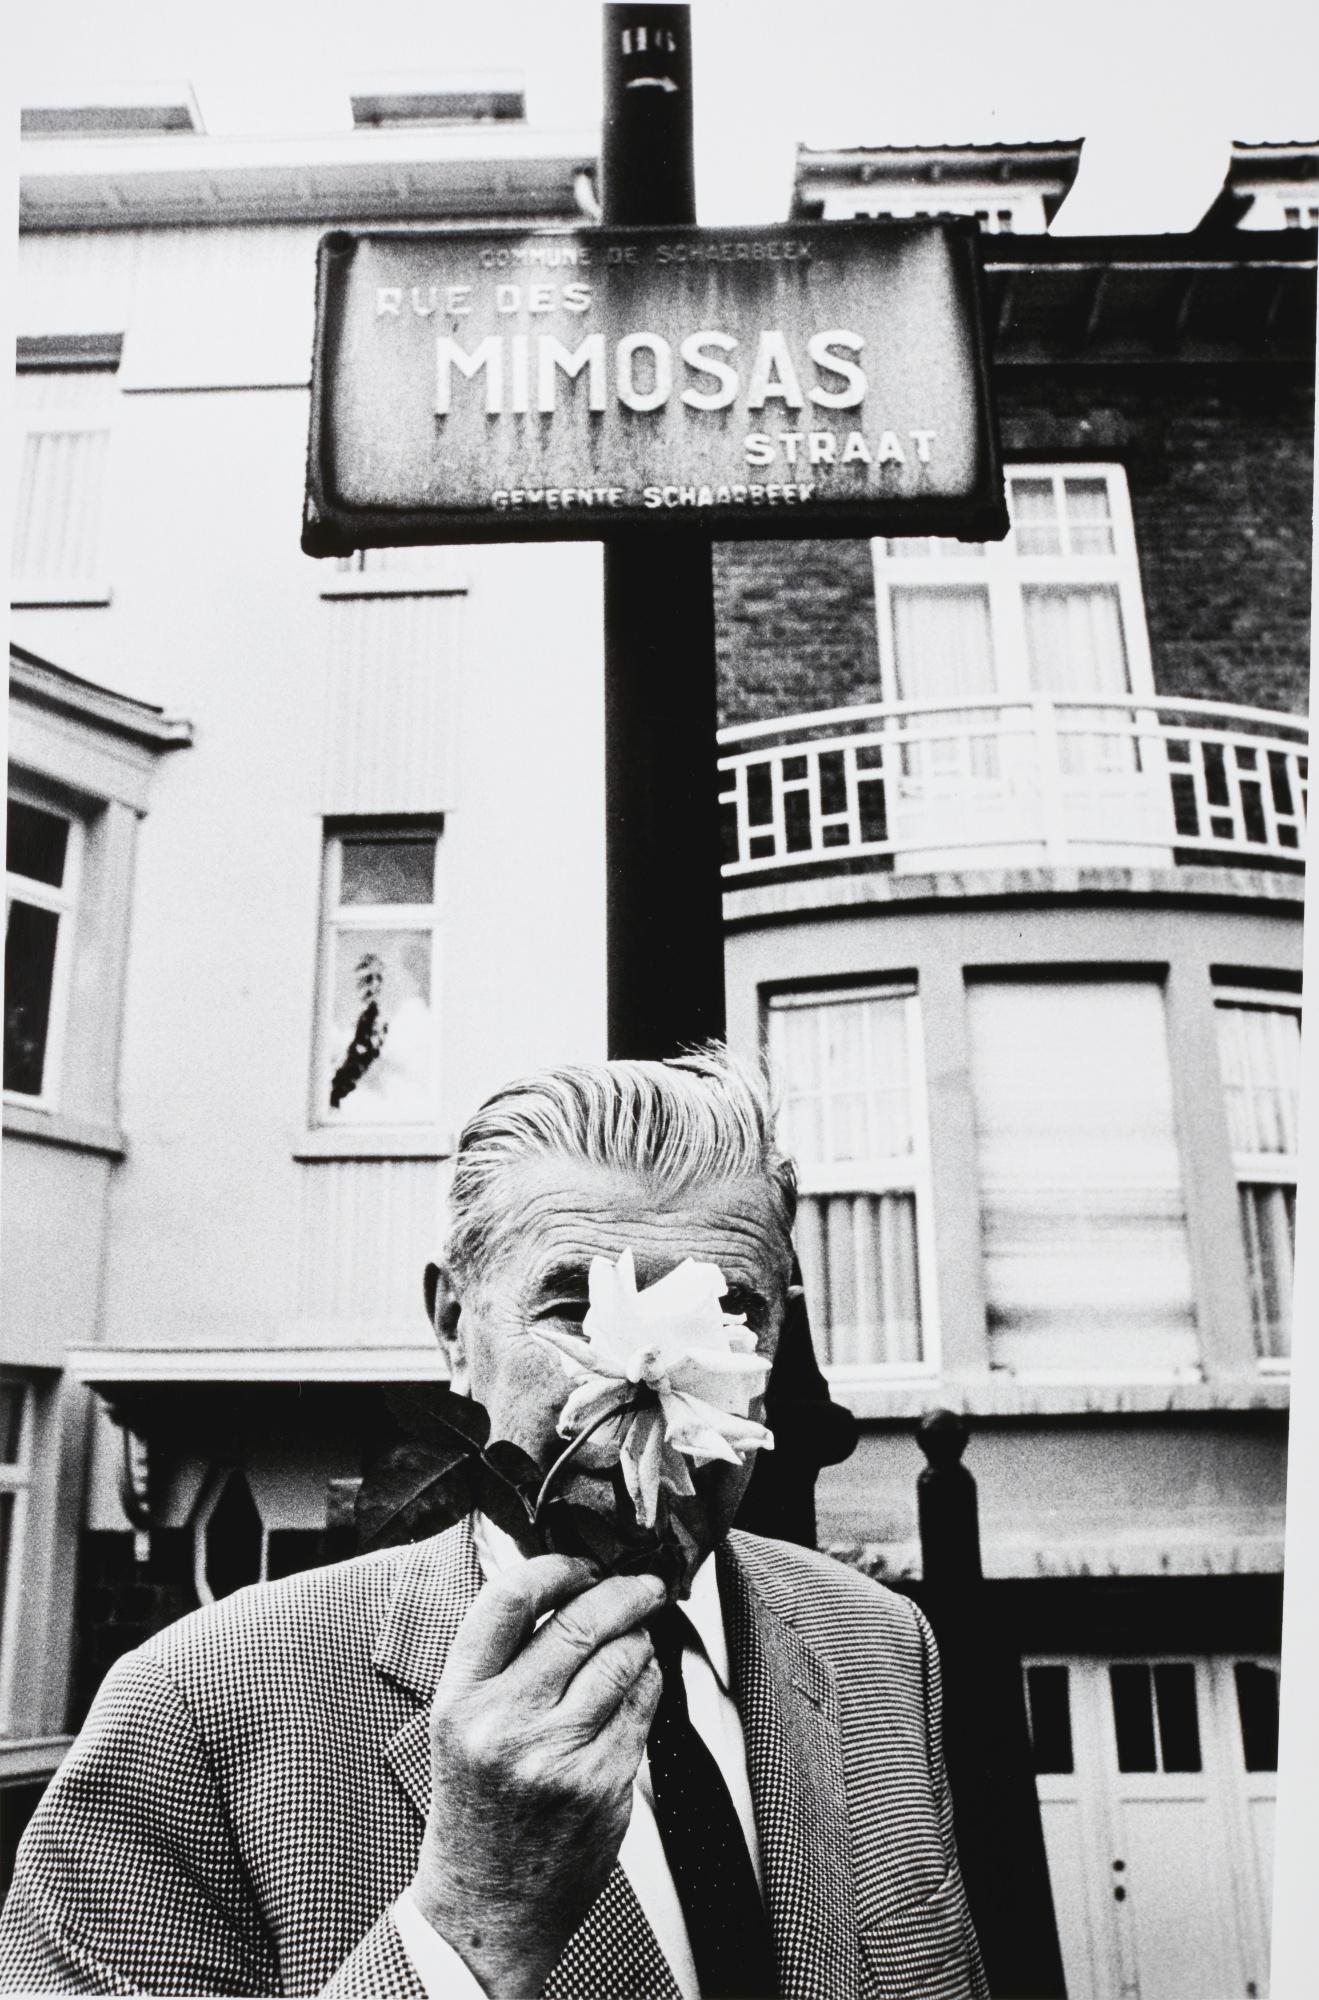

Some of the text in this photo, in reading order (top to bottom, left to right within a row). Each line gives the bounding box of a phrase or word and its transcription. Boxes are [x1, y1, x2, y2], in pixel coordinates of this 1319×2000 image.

[608, 246, 638, 264] DE
[376, 282, 591, 316] RUE DES
[434, 330, 868, 413] MIMOSAS
[744, 429, 937, 465] STRAAT
